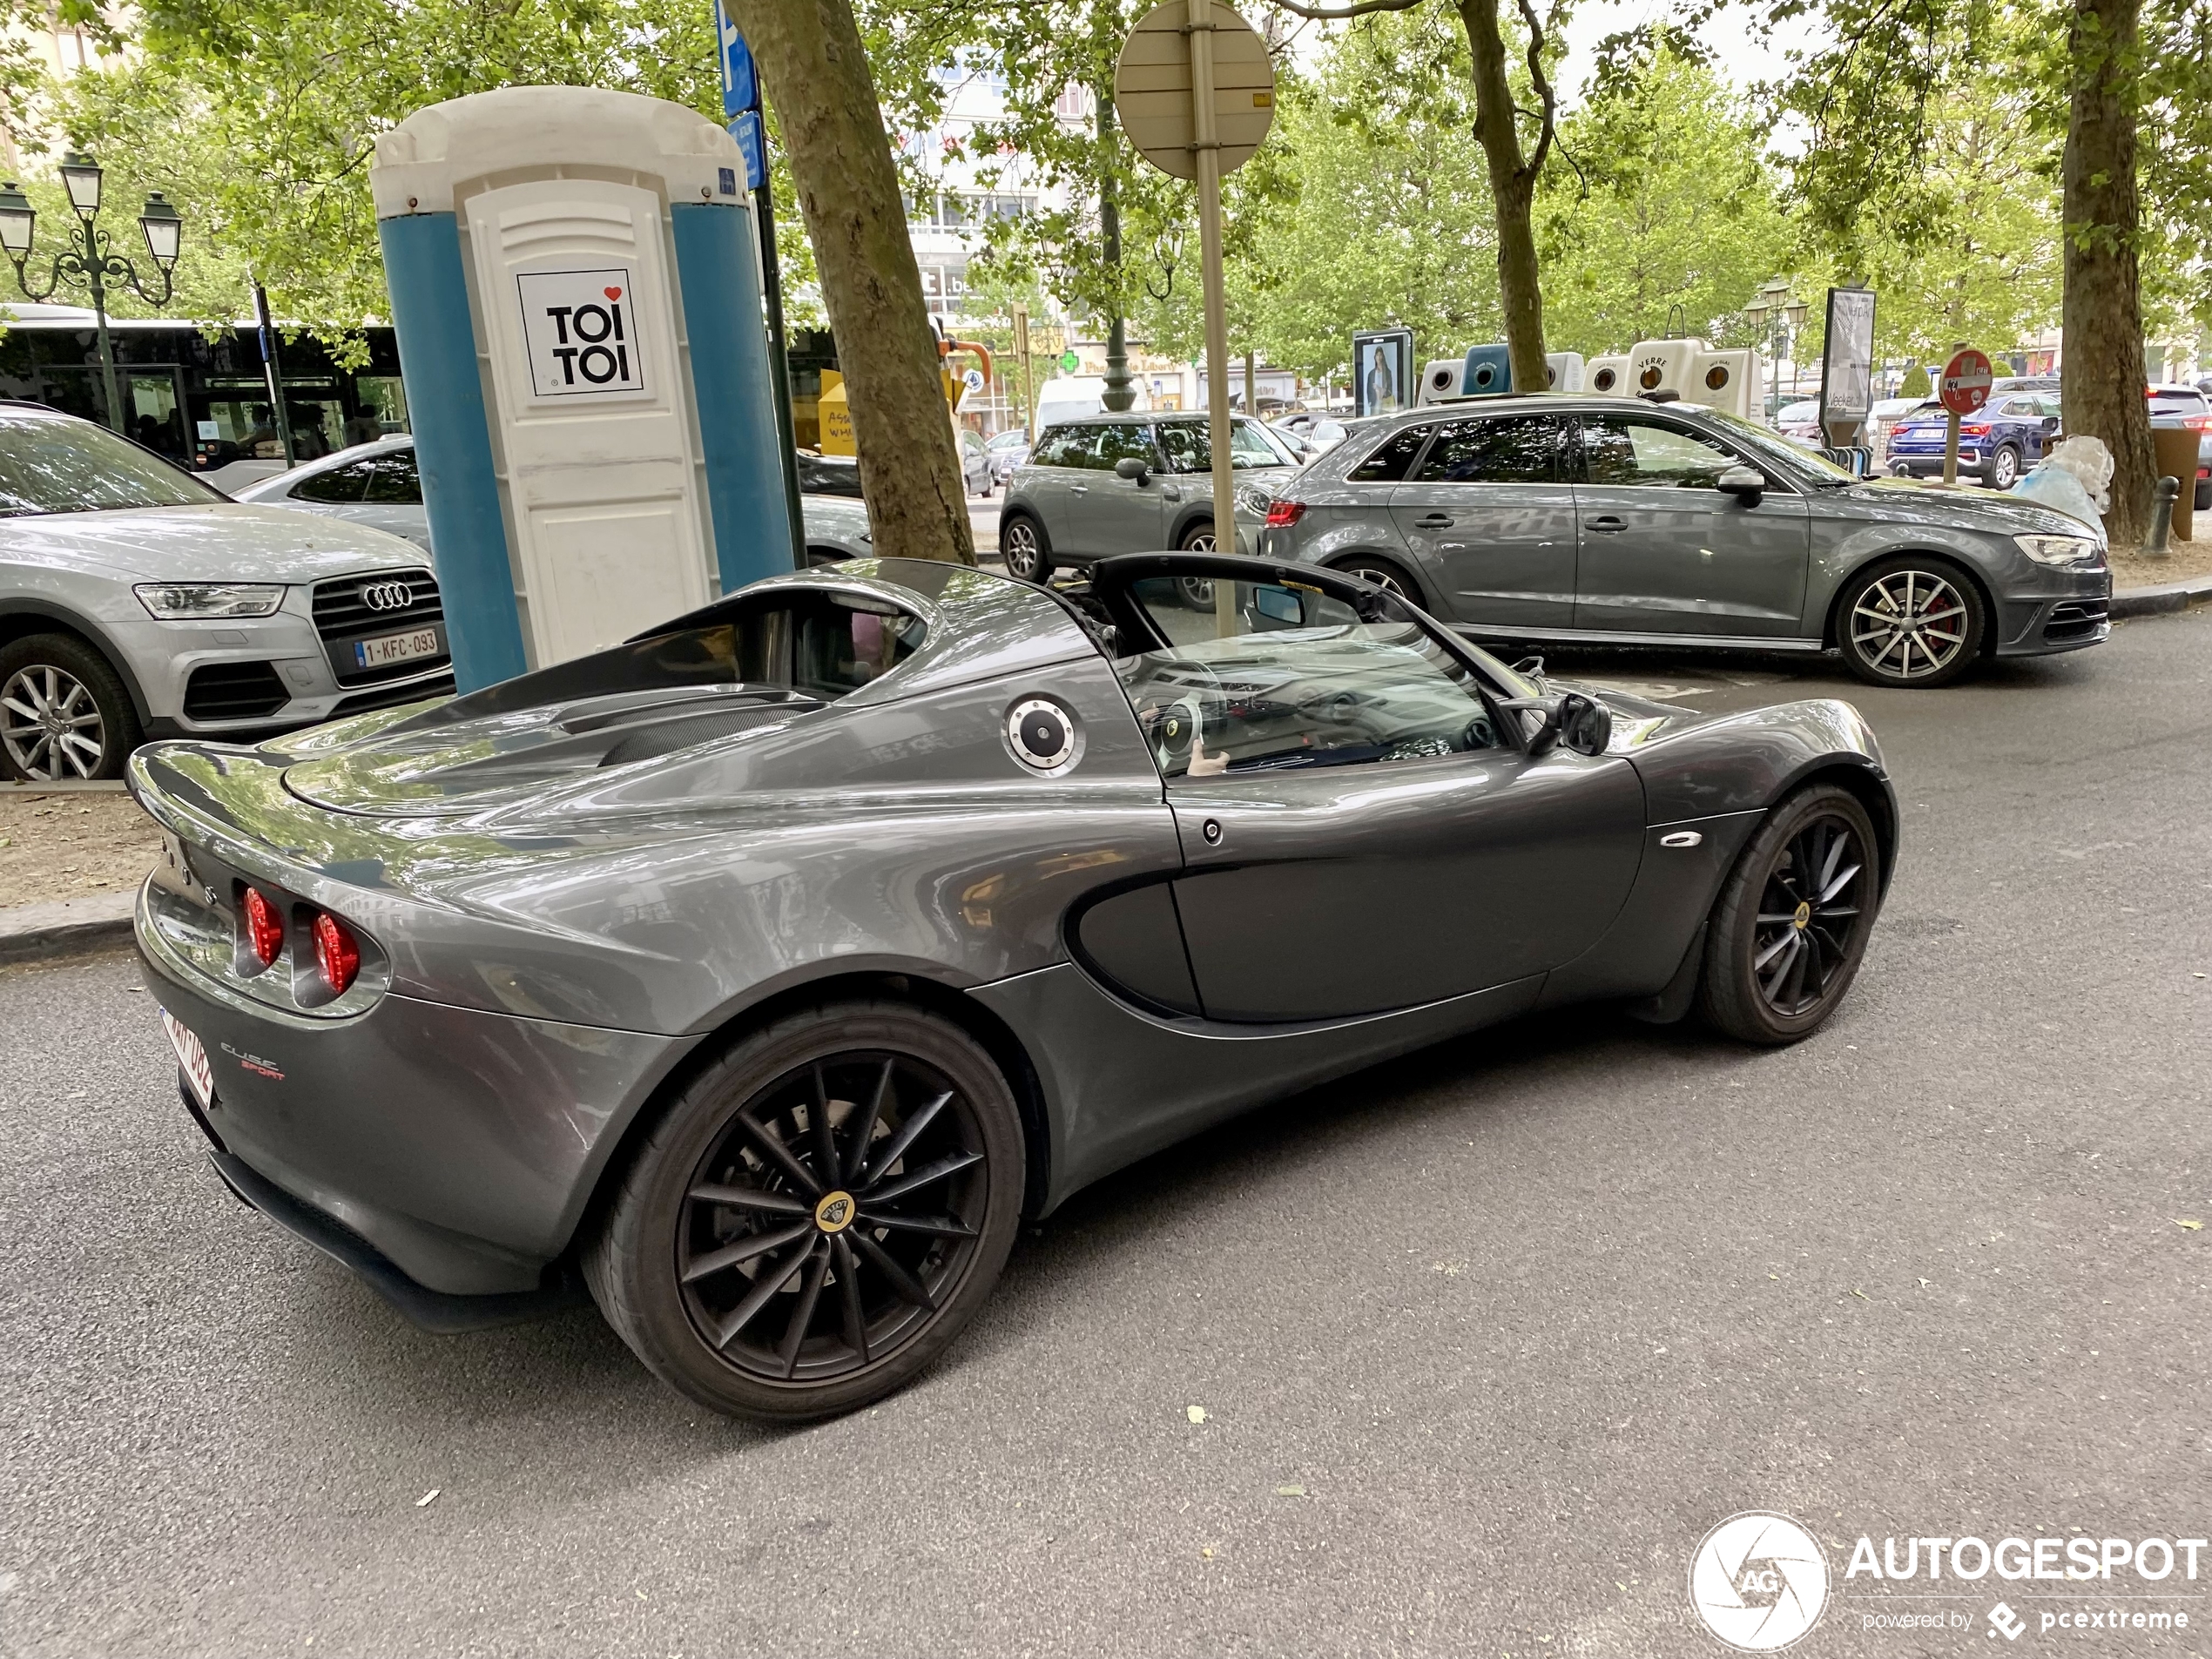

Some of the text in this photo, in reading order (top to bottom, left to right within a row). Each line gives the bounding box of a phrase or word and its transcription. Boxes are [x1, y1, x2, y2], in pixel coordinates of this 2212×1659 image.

[546, 304, 624, 344] TOI
[552, 345, 630, 385] TOI
[1085, 360, 1177, 374] Phaie Liberty
[1638, 357, 1667, 368] VERRE
[367, 633, 435, 662] 1-KFC-093
[221, 1042, 280, 1071] ELISE
[241, 1060, 286, 1080] SPORT
[821, 1200, 847, 1219] LOTUS
